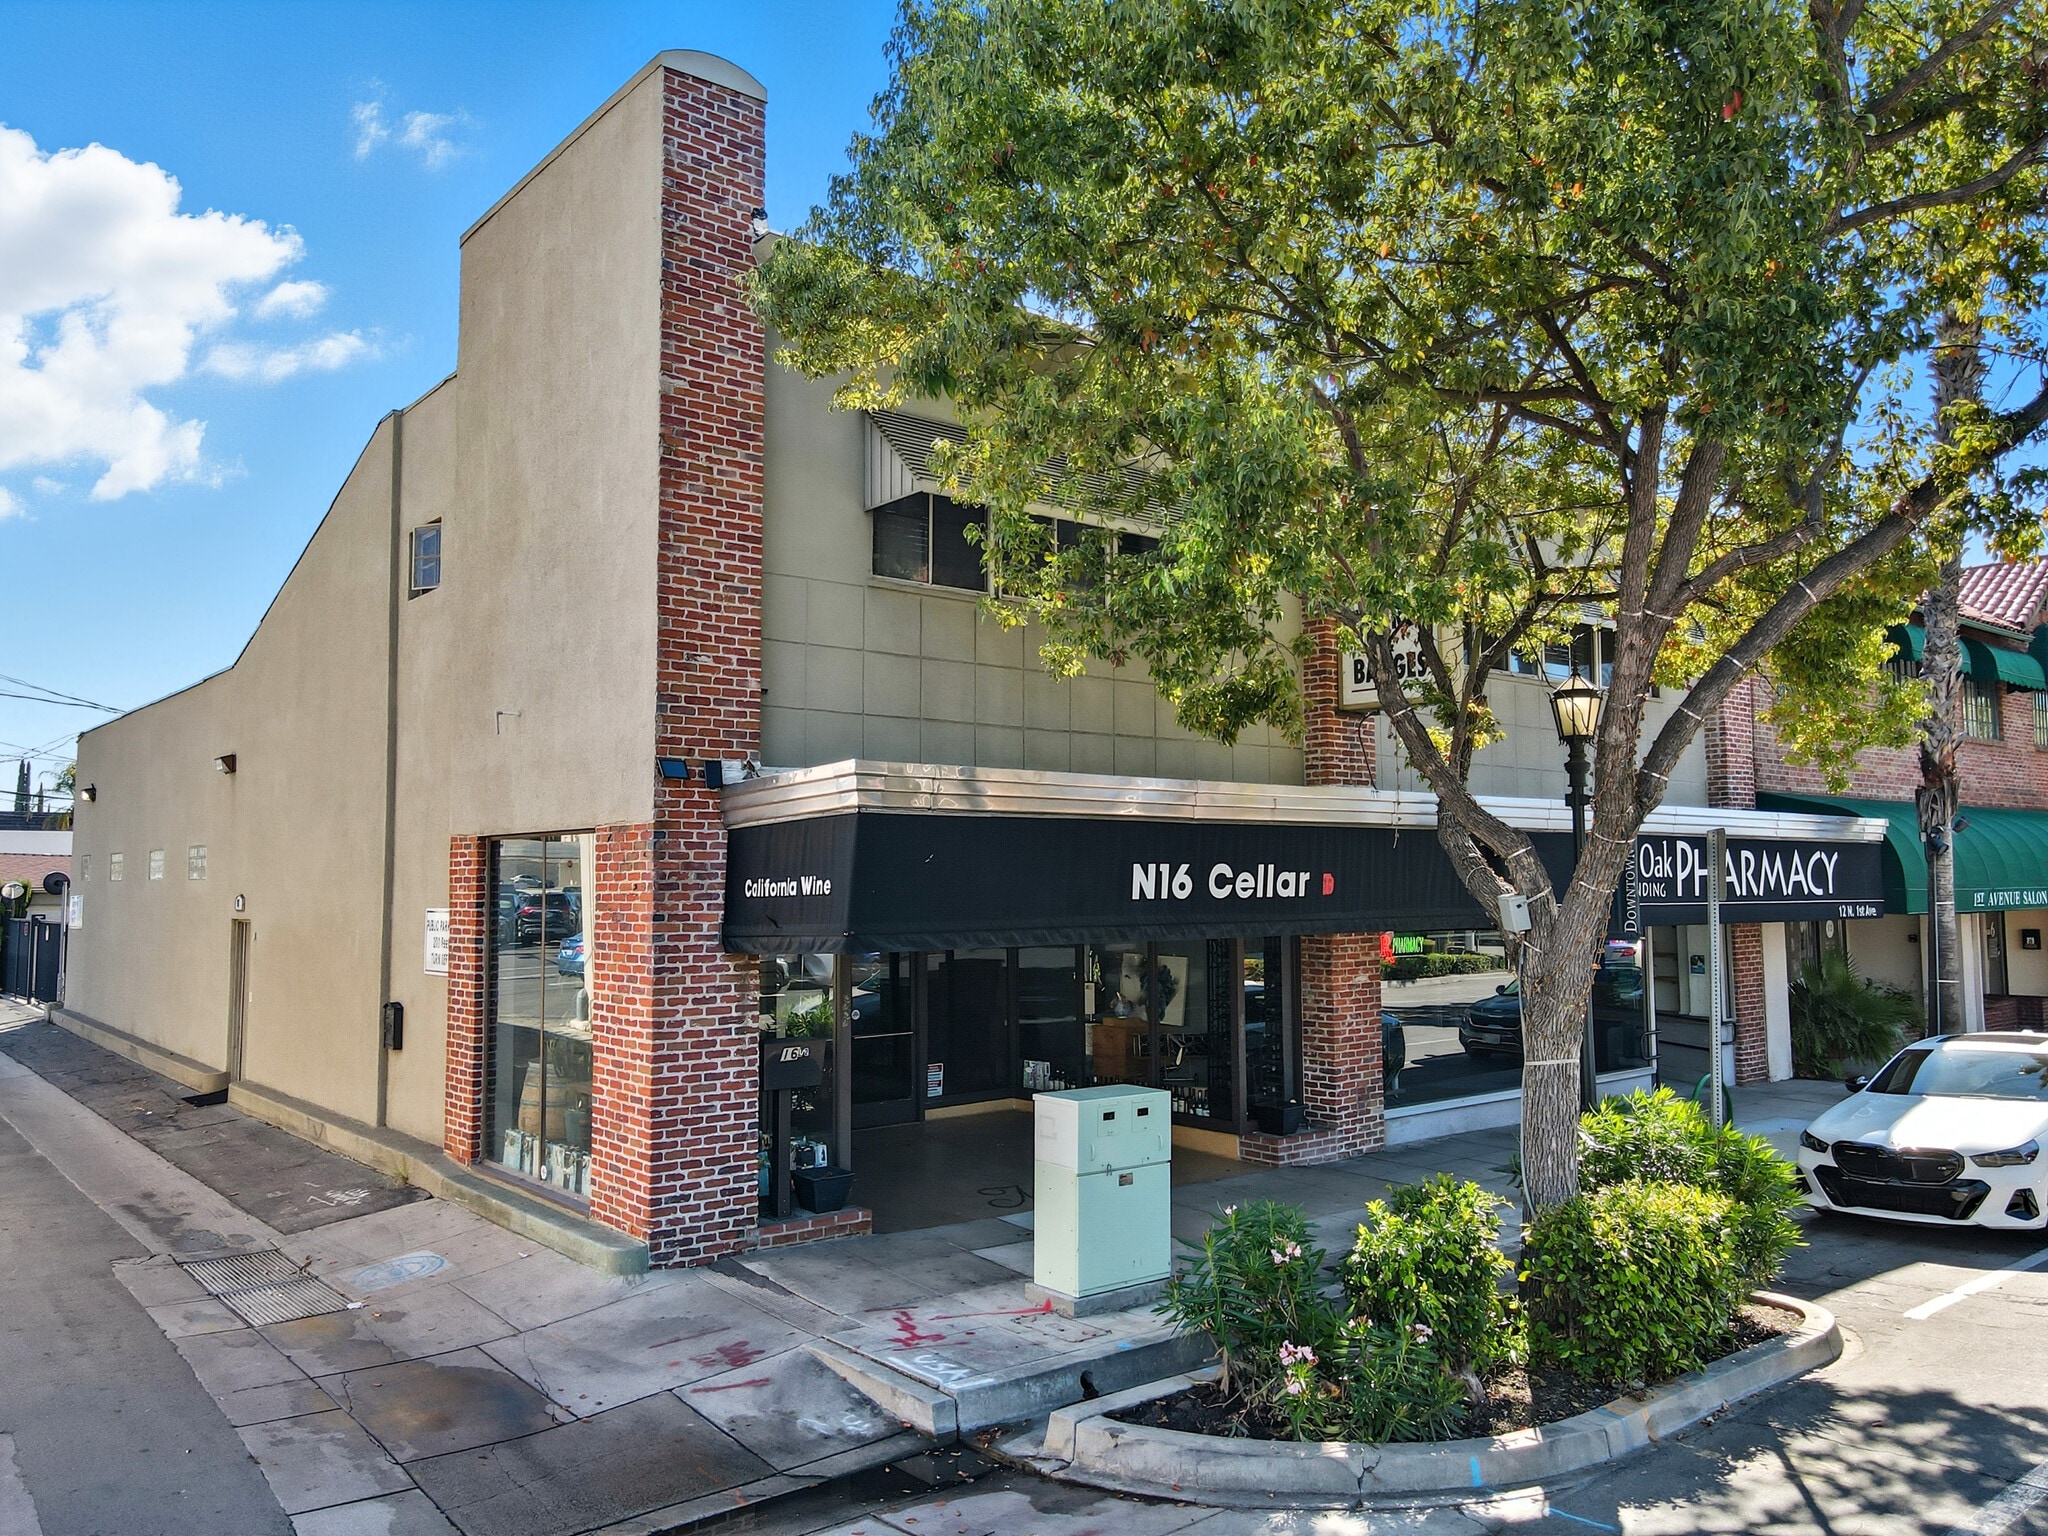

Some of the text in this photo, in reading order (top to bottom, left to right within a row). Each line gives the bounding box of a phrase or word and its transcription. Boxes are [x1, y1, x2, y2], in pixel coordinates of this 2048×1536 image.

[1353, 651, 1428, 685] BAGES
[1640, 840, 1838, 897] Oak PHARMACY
[745, 876, 831, 897] California Wine
[1132, 863, 1193, 900] N16
[1208, 863, 1311, 899] Cellar
[1988, 891, 2020, 907] AVENUE
[2023, 890, 2048, 905] SALON
[1839, 904, 1846, 917] 12
[1856, 904, 1865, 917] 1st
[1865, 904, 1877, 917] Ave
[440, 920, 450, 932] PAR
[1392, 936, 1424, 954] PHARMACY
